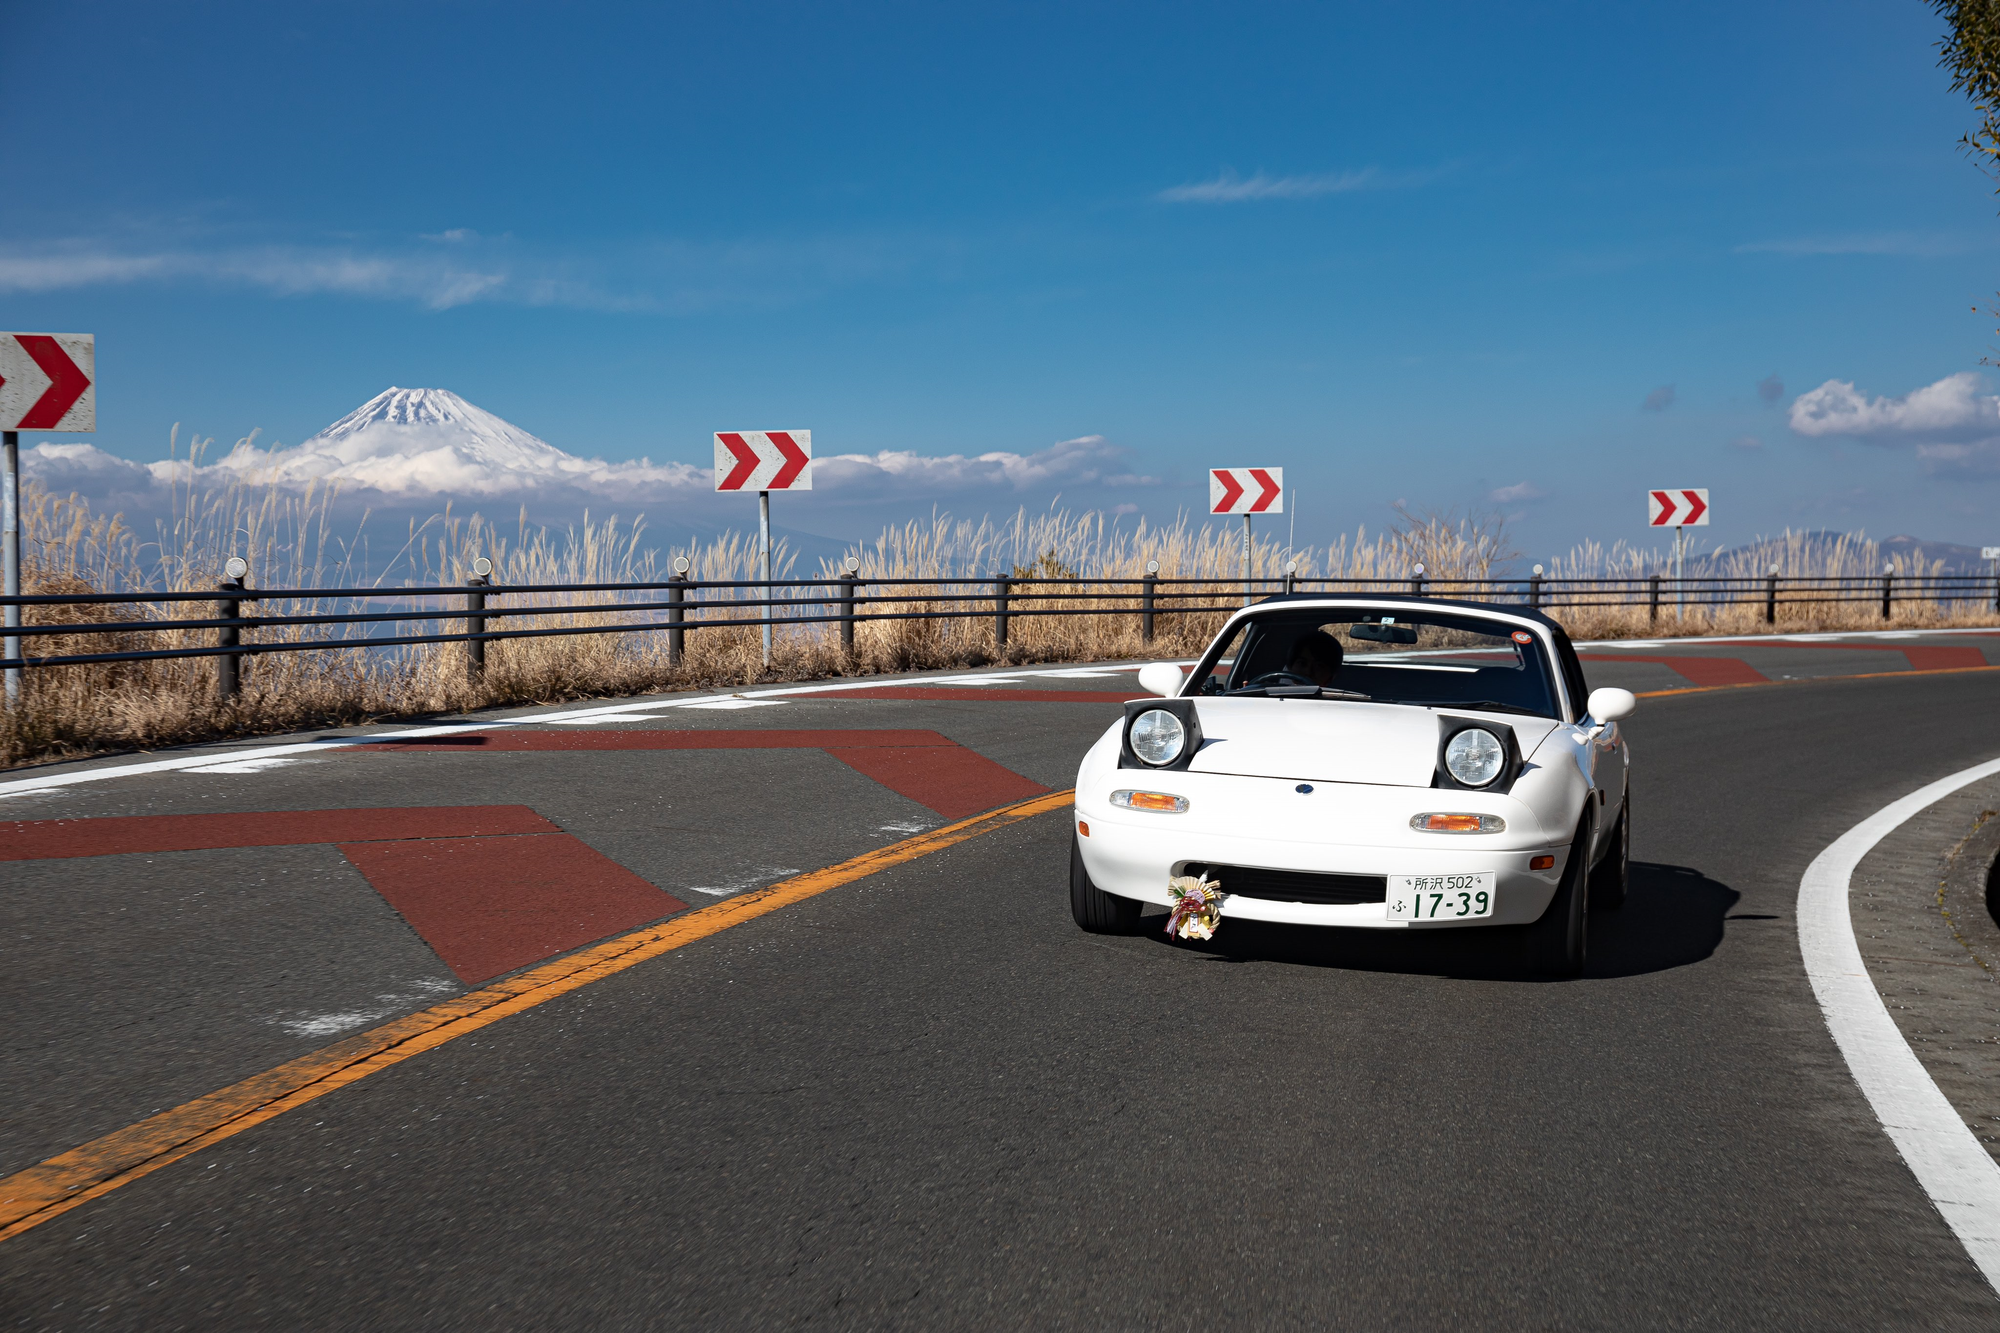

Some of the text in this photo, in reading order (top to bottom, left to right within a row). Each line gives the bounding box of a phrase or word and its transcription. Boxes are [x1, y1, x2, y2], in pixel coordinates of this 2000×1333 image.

[1414, 876, 1473, 891] 所沢 502
[1392, 891, 1488, 919] ふ 17-39
